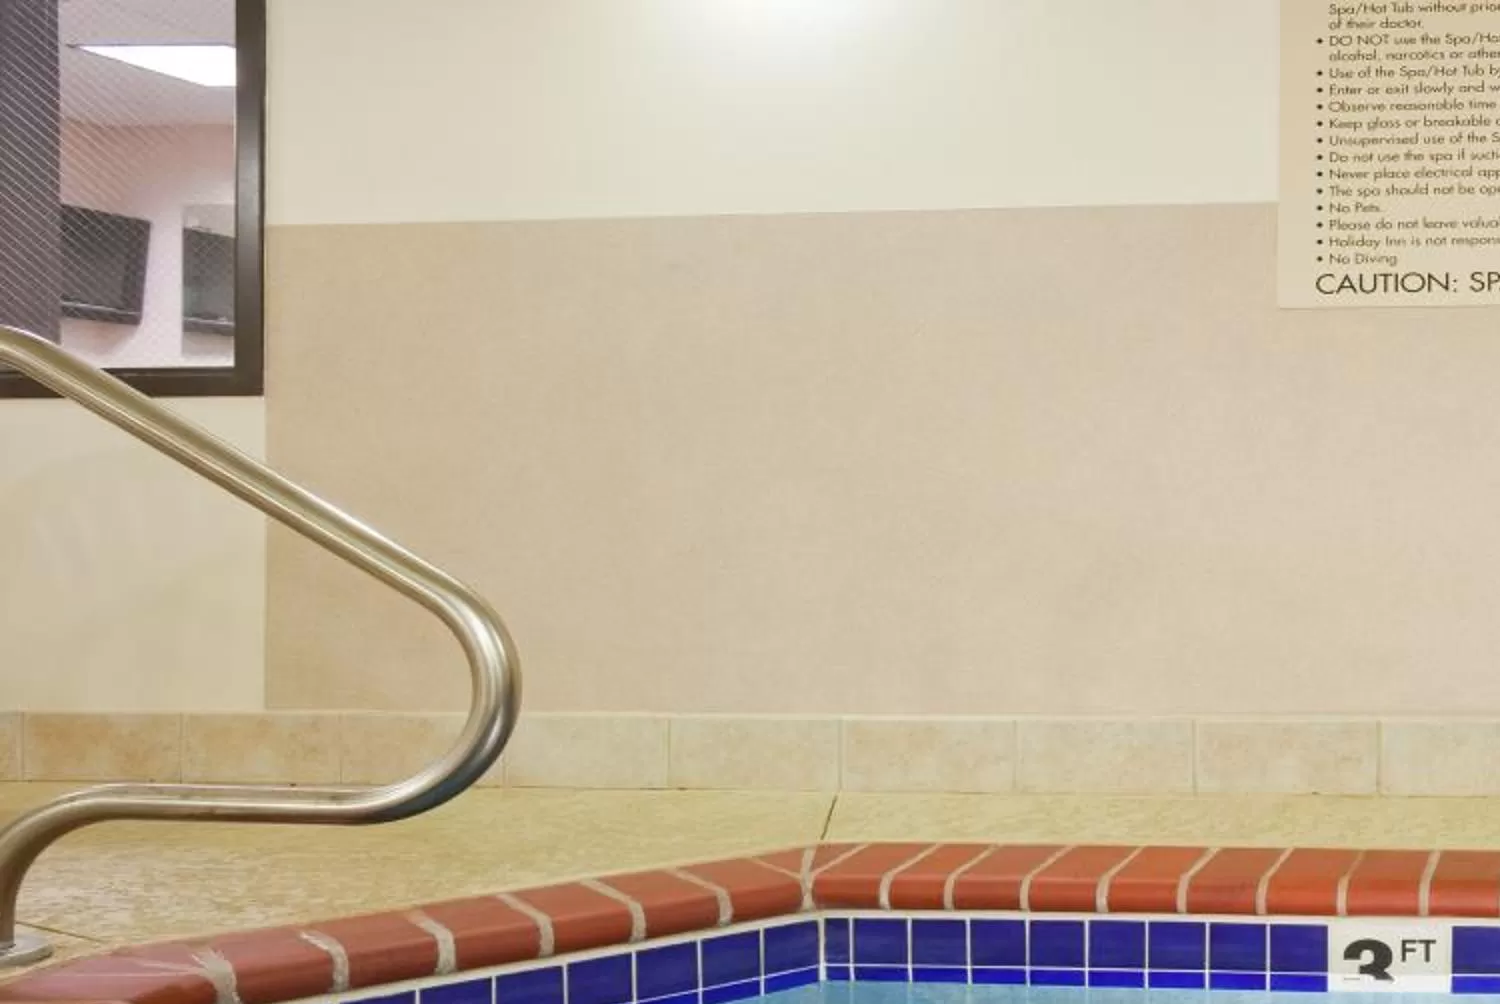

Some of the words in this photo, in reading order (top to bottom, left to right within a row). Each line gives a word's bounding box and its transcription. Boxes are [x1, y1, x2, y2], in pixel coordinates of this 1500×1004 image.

[1329, 2, 1388, 17] Spa/Hot
[1391, 1, 1414, 13] Tub
[1418, 0, 1467, 13] without
[1328, 17, 1343, 31] of
[1346, 17, 1376, 30] their
[1329, 35, 1353, 46] DO
[1356, 34, 1390, 46] NOT
[1394, 37, 1417, 45] use
[1420, 32, 1441, 44] the
[1385, 50, 1445, 60] narcotics
[1449, 51, 1464, 59] or
[1329, 68, 1354, 79] Use
[1357, 65, 1372, 79] of
[1375, 65, 1397, 78] the
[1399, 65, 1459, 80] Spa/Hot
[1461, 63, 1486, 77] Tub
[1329, 83, 1363, 96] Enter
[1367, 87, 1381, 95] or
[1385, 84, 1409, 95] exit
[1413, 81, 1456, 96] slowly
[1458, 80, 1485, 93] and
[1328, 100, 1387, 112] Observe
[1389, 98, 1465, 111] reasonable
[1468, 98, 1497, 109] time
[1329, 118, 1363, 132] Keep
[1367, 116, 1402, 131] glass
[1404, 120, 1420, 128] or
[1423, 114, 1492, 128] breakable
[1329, 132, 1419, 148] Unsupervised
[1423, 136, 1445, 144] use
[1449, 131, 1464, 144] of
[1467, 131, 1488, 144] the
[1329, 151, 1349, 163] Do
[1352, 152, 1374, 163] not
[1377, 154, 1400, 162] use
[1403, 150, 1424, 161] the
[1429, 153, 1453, 164] spa
[1457, 148, 1465, 160] if
[1329, 168, 1370, 180] Never
[1373, 167, 1411, 182] place
[1413, 165, 1473, 178] electrical
[1328, 184, 1353, 196] The
[1357, 188, 1381, 199] spa
[1385, 183, 1429, 196] should
[1433, 185, 1454, 195] not
[1458, 182, 1475, 194] be
[1329, 202, 1351, 213] No
[1329, 218, 1371, 231] Please
[1375, 218, 1393, 230] do
[1397, 220, 1419, 230] not
[1422, 217, 1458, 229] leave
[1329, 234, 1381, 250] Holiday
[1385, 236, 1406, 246] Inn
[1411, 236, 1422, 247] is
[1425, 237, 1447, 246] not
[1329, 253, 1351, 265] No
[1315, 271, 1458, 295] CAUTION:
[1401, 939, 1437, 962] FT
